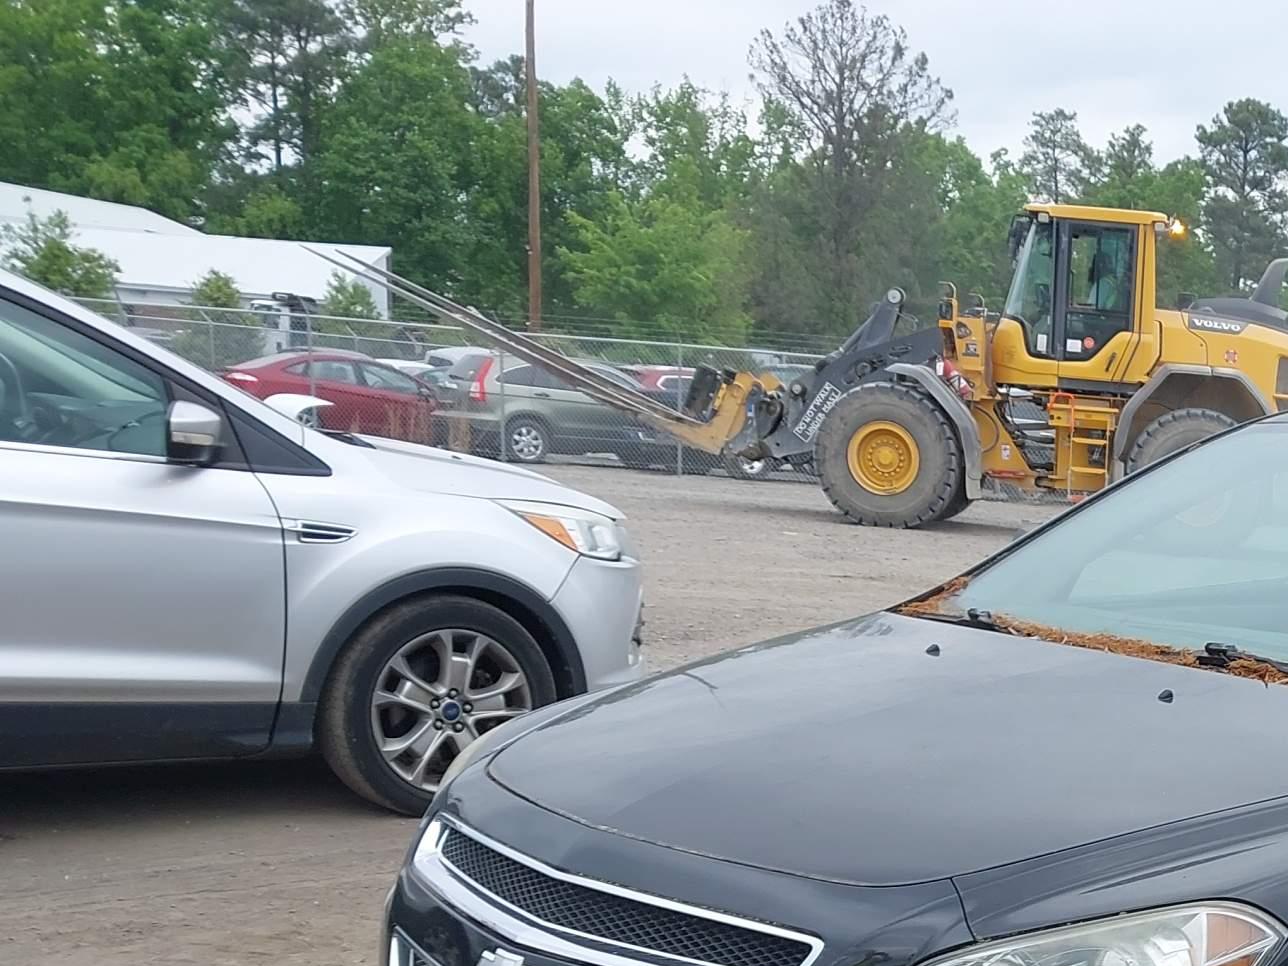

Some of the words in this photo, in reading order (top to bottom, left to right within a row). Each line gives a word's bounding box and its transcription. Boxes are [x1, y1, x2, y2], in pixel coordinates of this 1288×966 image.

[1192, 318, 1240, 332] VOLVO
[795, 422, 807, 434] DO
[803, 405, 818, 423] NOT
